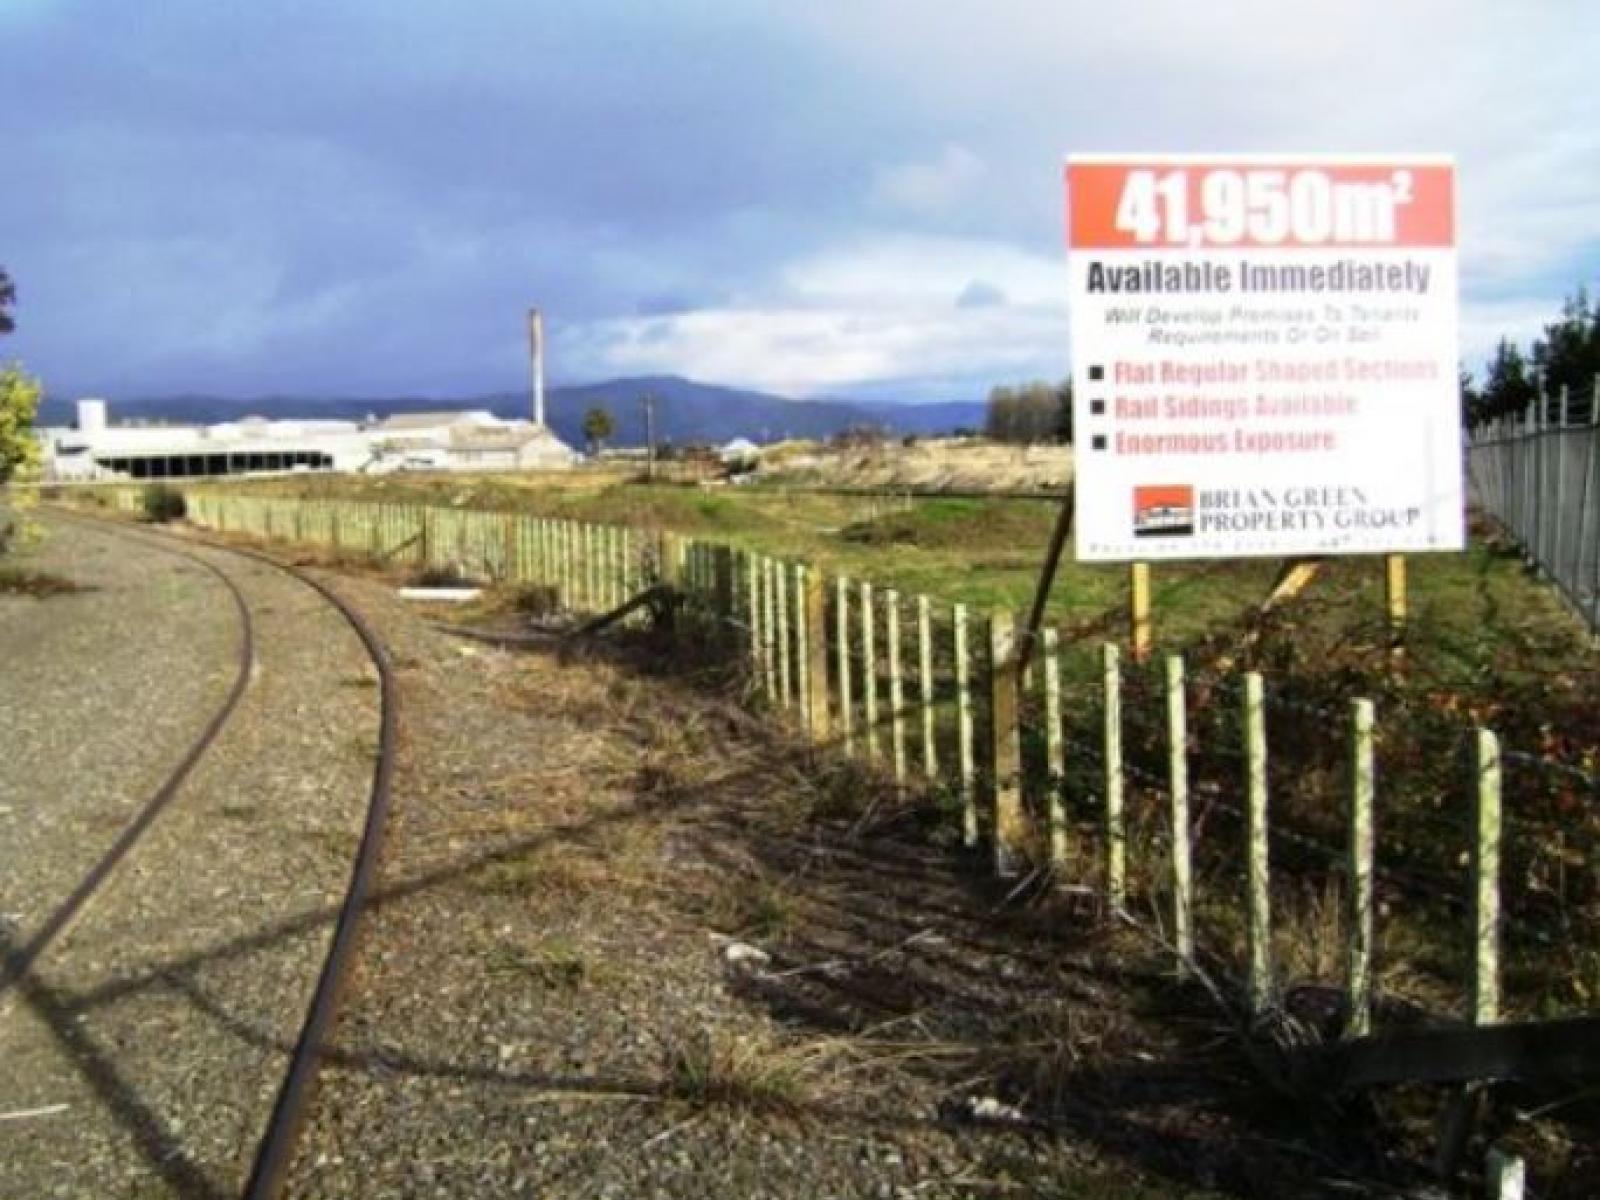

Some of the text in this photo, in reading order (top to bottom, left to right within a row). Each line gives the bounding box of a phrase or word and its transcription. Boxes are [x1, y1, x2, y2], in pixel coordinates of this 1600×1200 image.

[1086, 259, 1430, 294] Available Immediately
[1146, 307, 1222, 326] Develop
[1115, 357, 1438, 386] Flat Regular Shaped Sections
[1115, 392, 1358, 420] Rail Sidings Available
[1115, 429, 1336, 456] Enormous Exposure
[1200, 486, 1367, 509] BRIAN GREEN
[1200, 507, 1421, 534] PROPERTY GROUP
